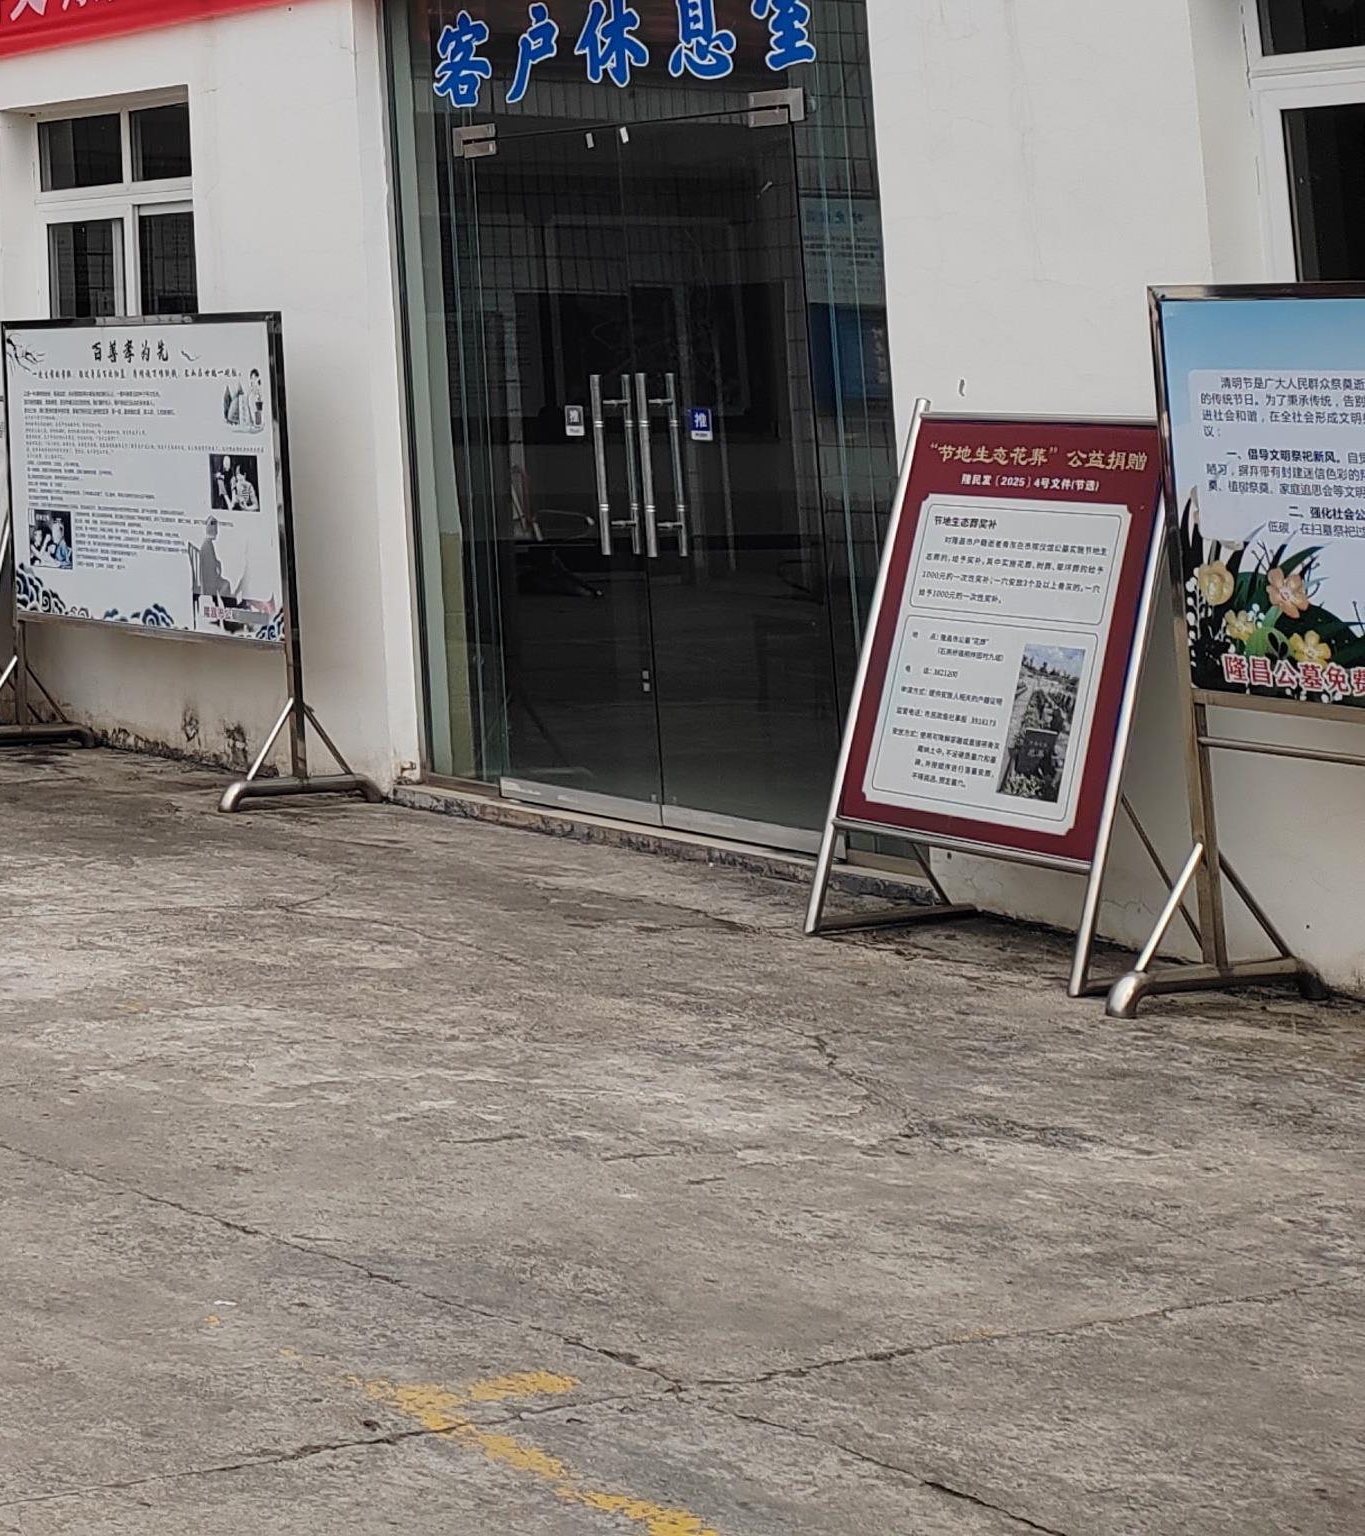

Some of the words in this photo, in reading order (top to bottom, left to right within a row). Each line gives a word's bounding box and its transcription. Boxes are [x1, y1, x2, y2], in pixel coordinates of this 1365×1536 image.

[694, 413, 708, 428] 推
[1202, 409, 1365, 425] 进社会和谐，在全社会形成文明
[1066, 450, 1148, 471] 公益捐赠
